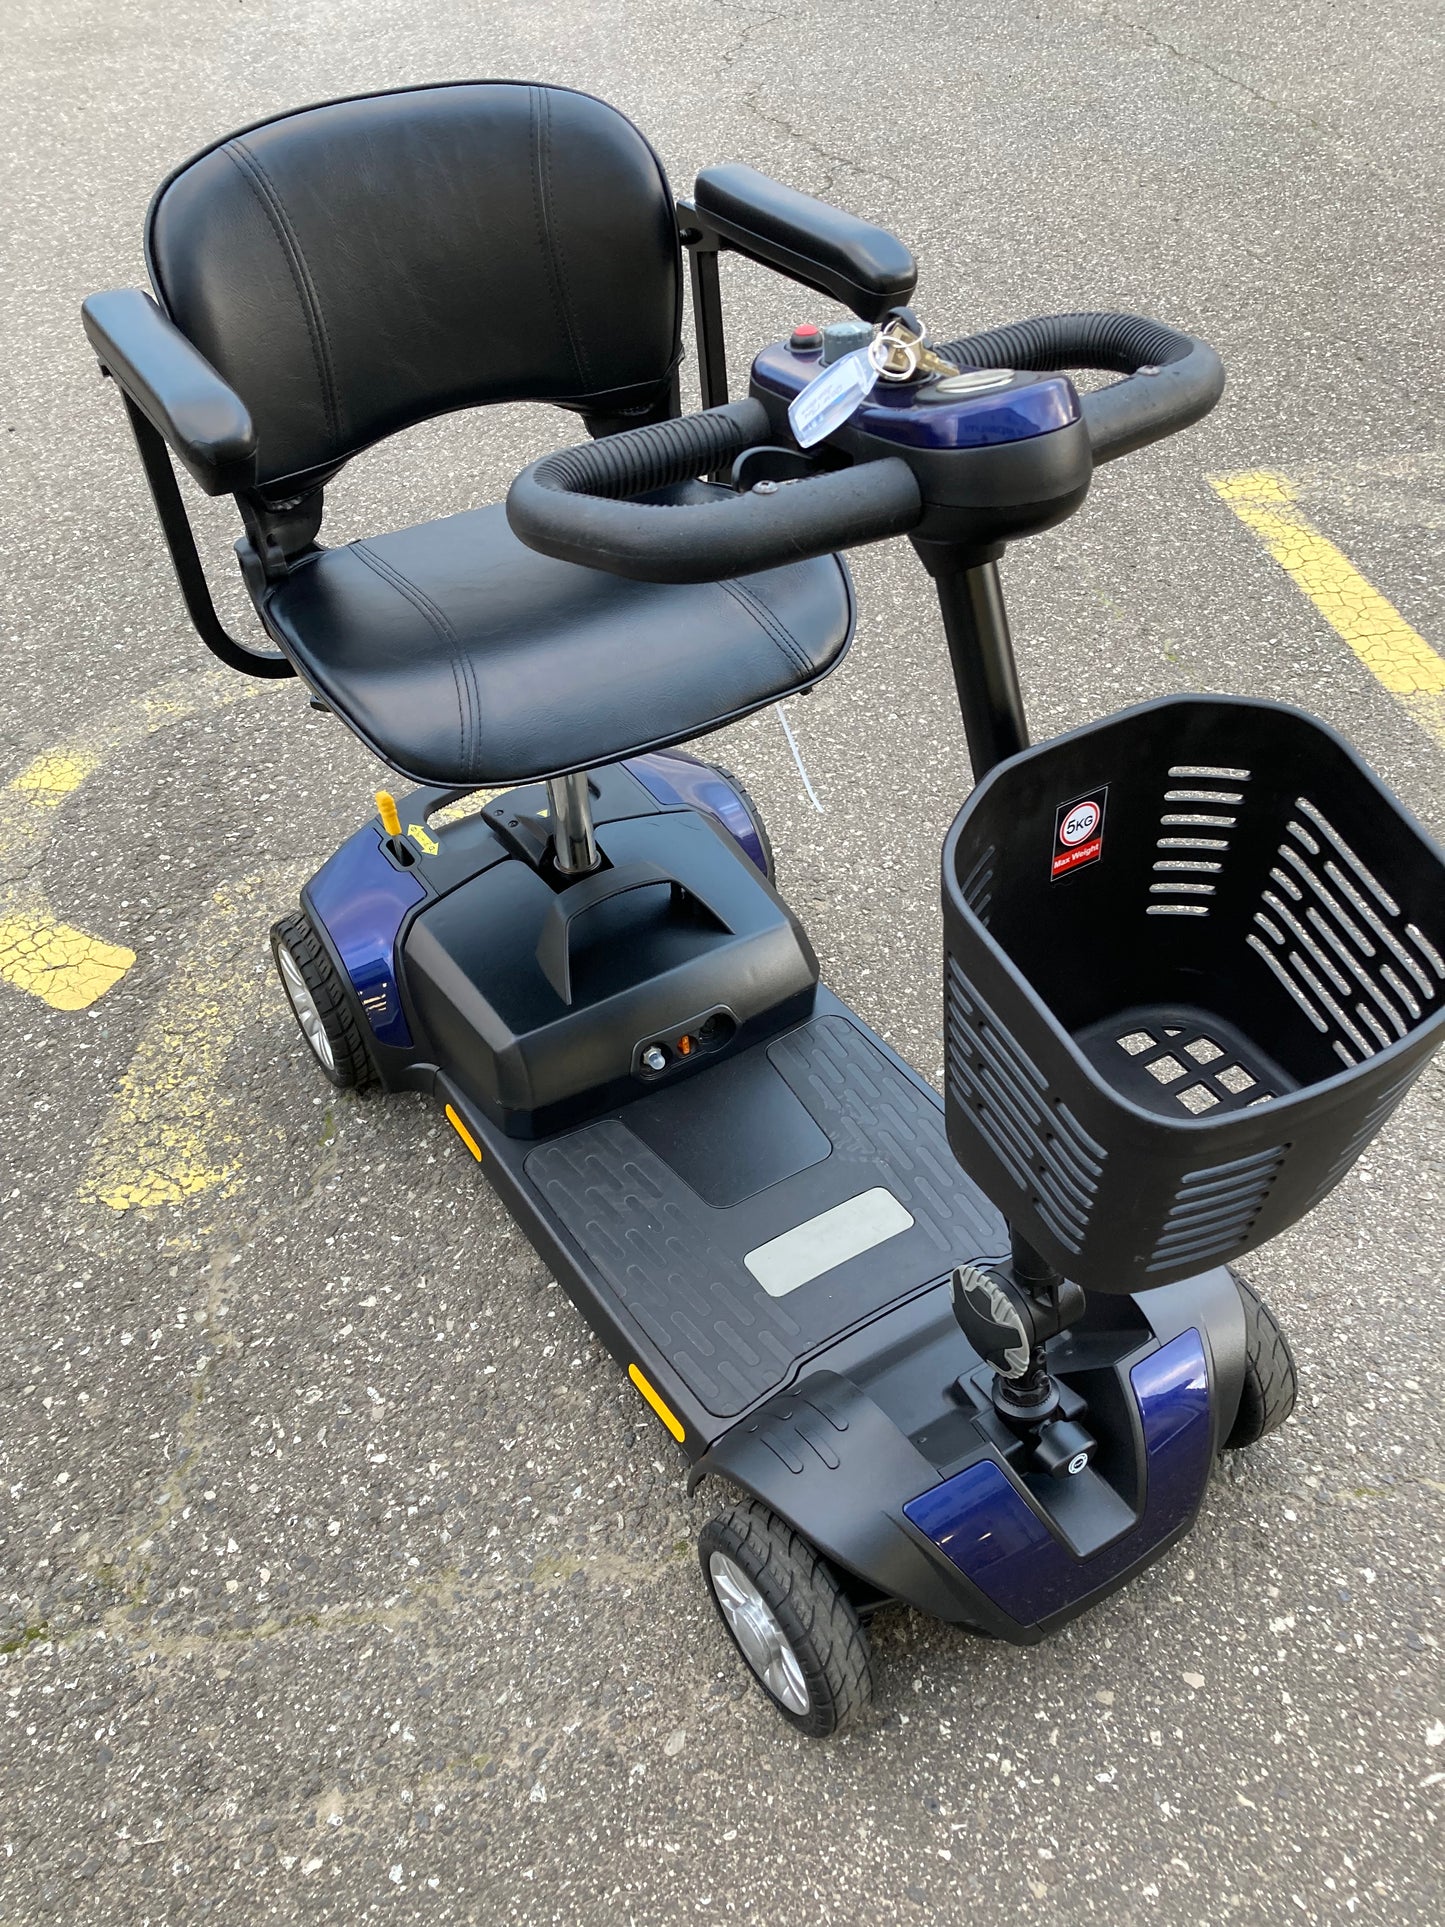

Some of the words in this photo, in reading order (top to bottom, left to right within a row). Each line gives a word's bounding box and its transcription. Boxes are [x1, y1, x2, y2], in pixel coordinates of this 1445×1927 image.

[1066, 815, 1093, 835] 5KG
[1053, 857, 1070, 869] Max
[1071, 843, 1099, 860] Weight
